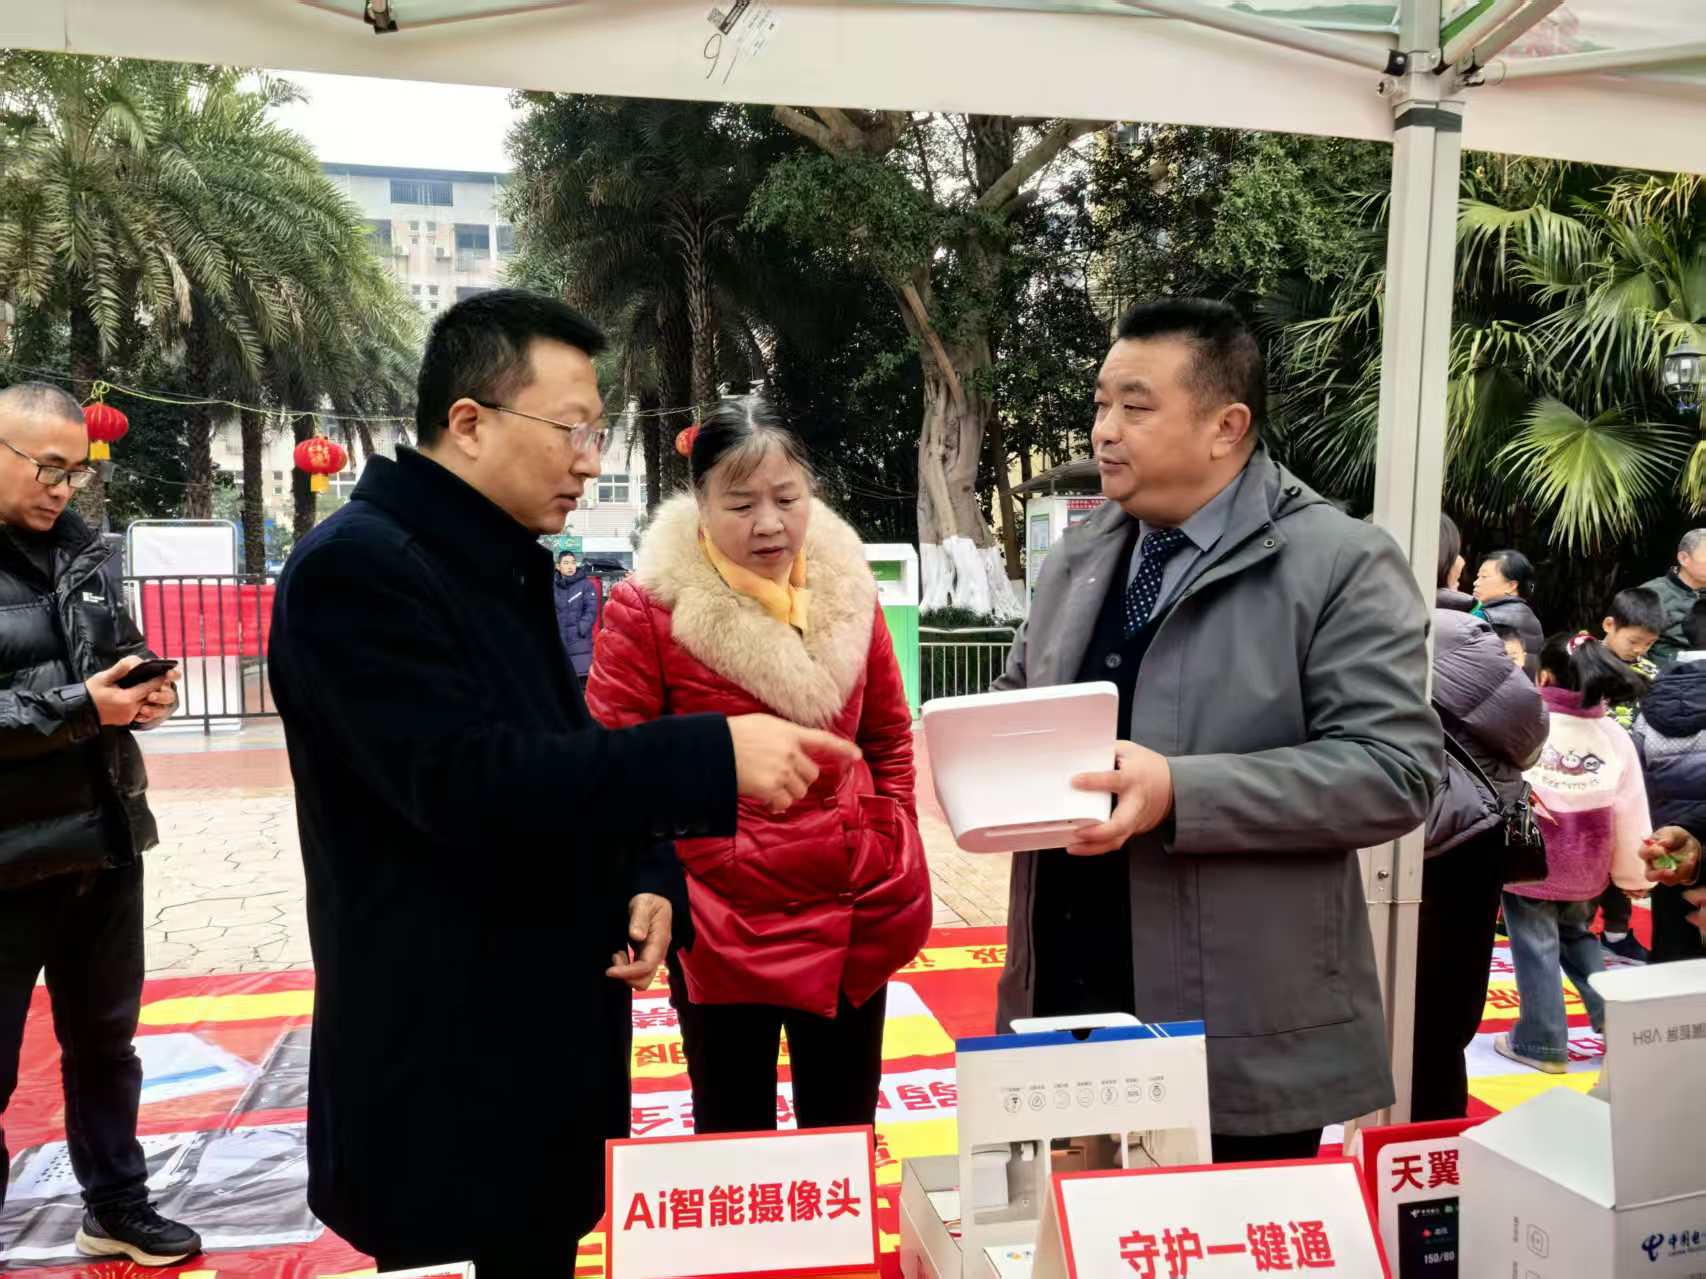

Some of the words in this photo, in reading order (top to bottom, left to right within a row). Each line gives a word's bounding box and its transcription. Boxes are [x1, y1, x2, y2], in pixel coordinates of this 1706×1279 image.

[623, 1177, 861, 1231] Ai智能摄像头
[1119, 1220, 1335, 1279] 守护一键通
